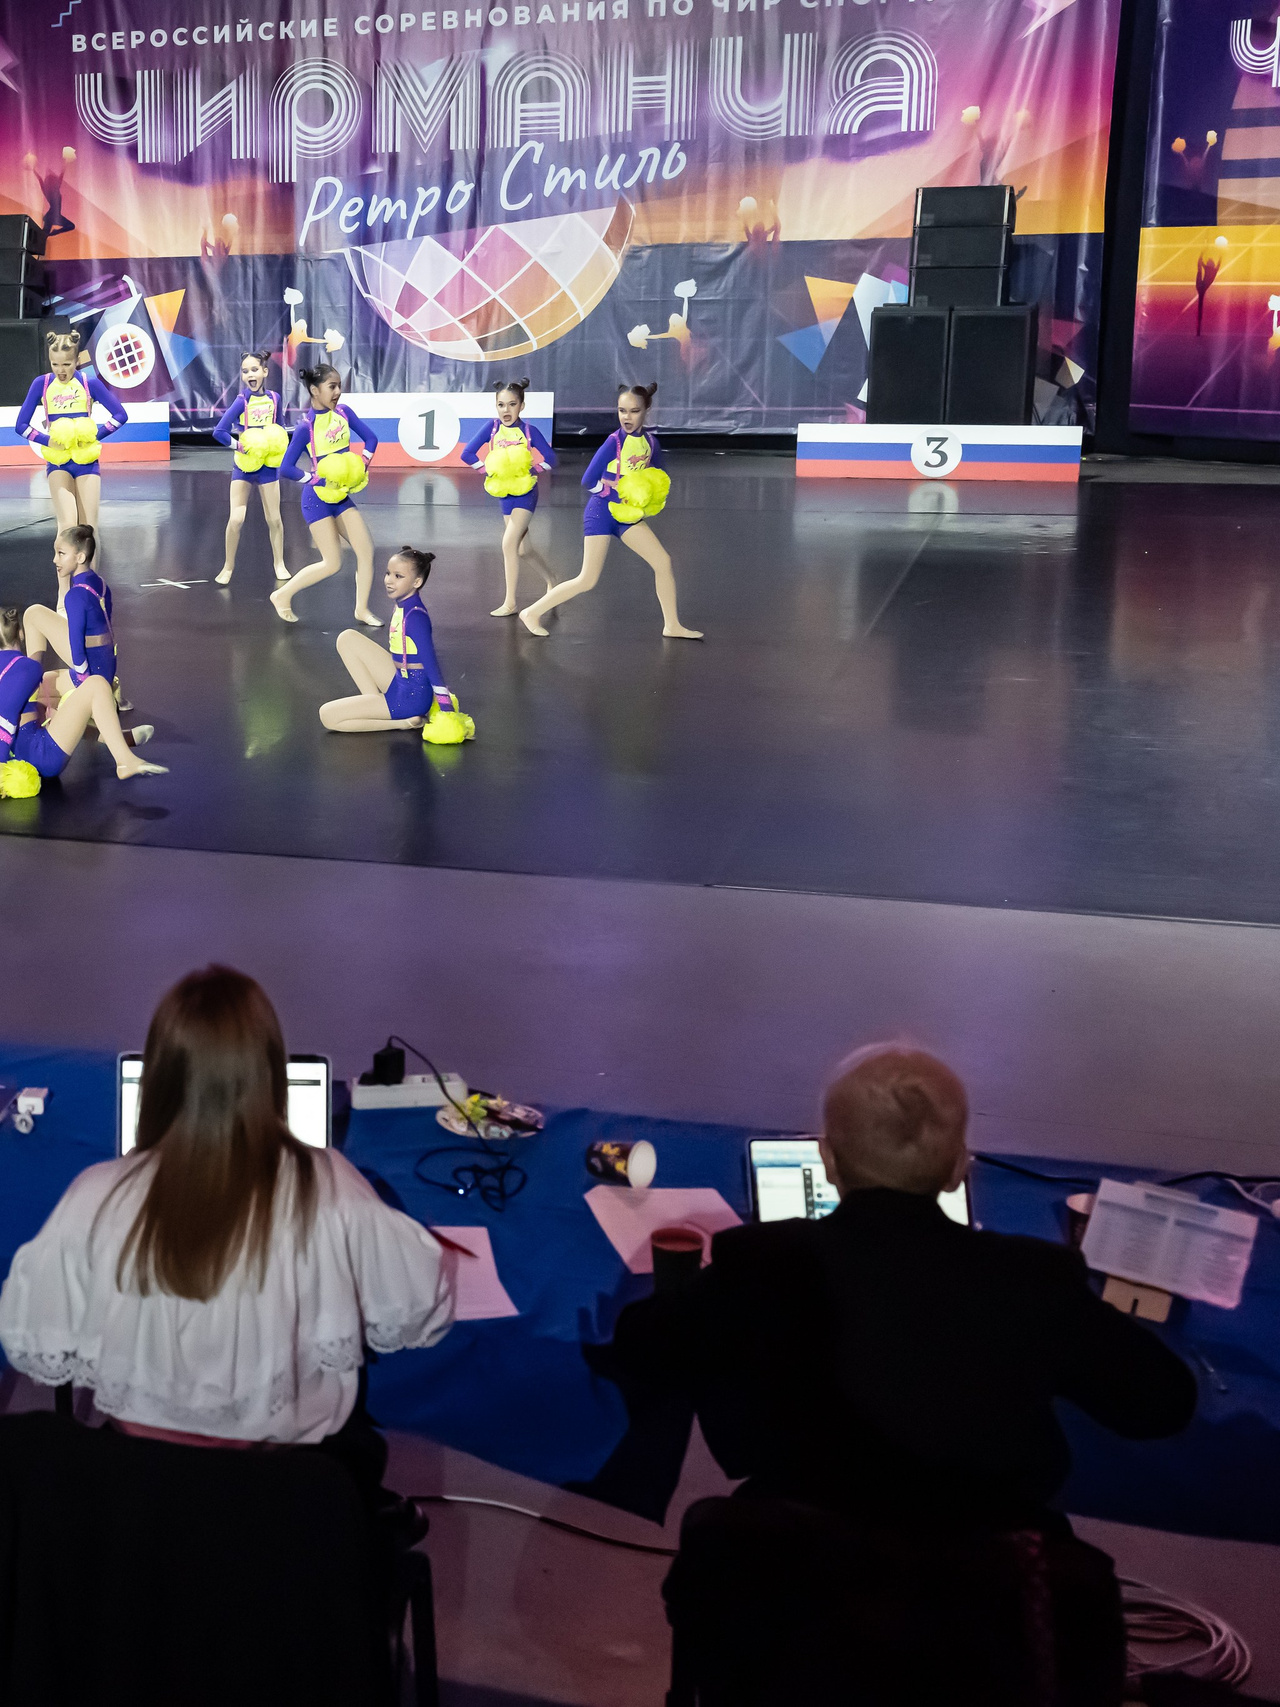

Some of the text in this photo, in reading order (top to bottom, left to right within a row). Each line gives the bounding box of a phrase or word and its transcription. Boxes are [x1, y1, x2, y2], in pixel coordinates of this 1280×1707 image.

[71, 16, 339, 53] ВСЕРОССИЙСКИЕ
[353, 0, 630, 36] СОРЕВНОВАНИЯ
[647, 0, 694, 17] ПО
[298, 140, 687, 247] Ретро Стиль
[417, 409, 440, 450] 1
[923, 436, 949, 468] 3
